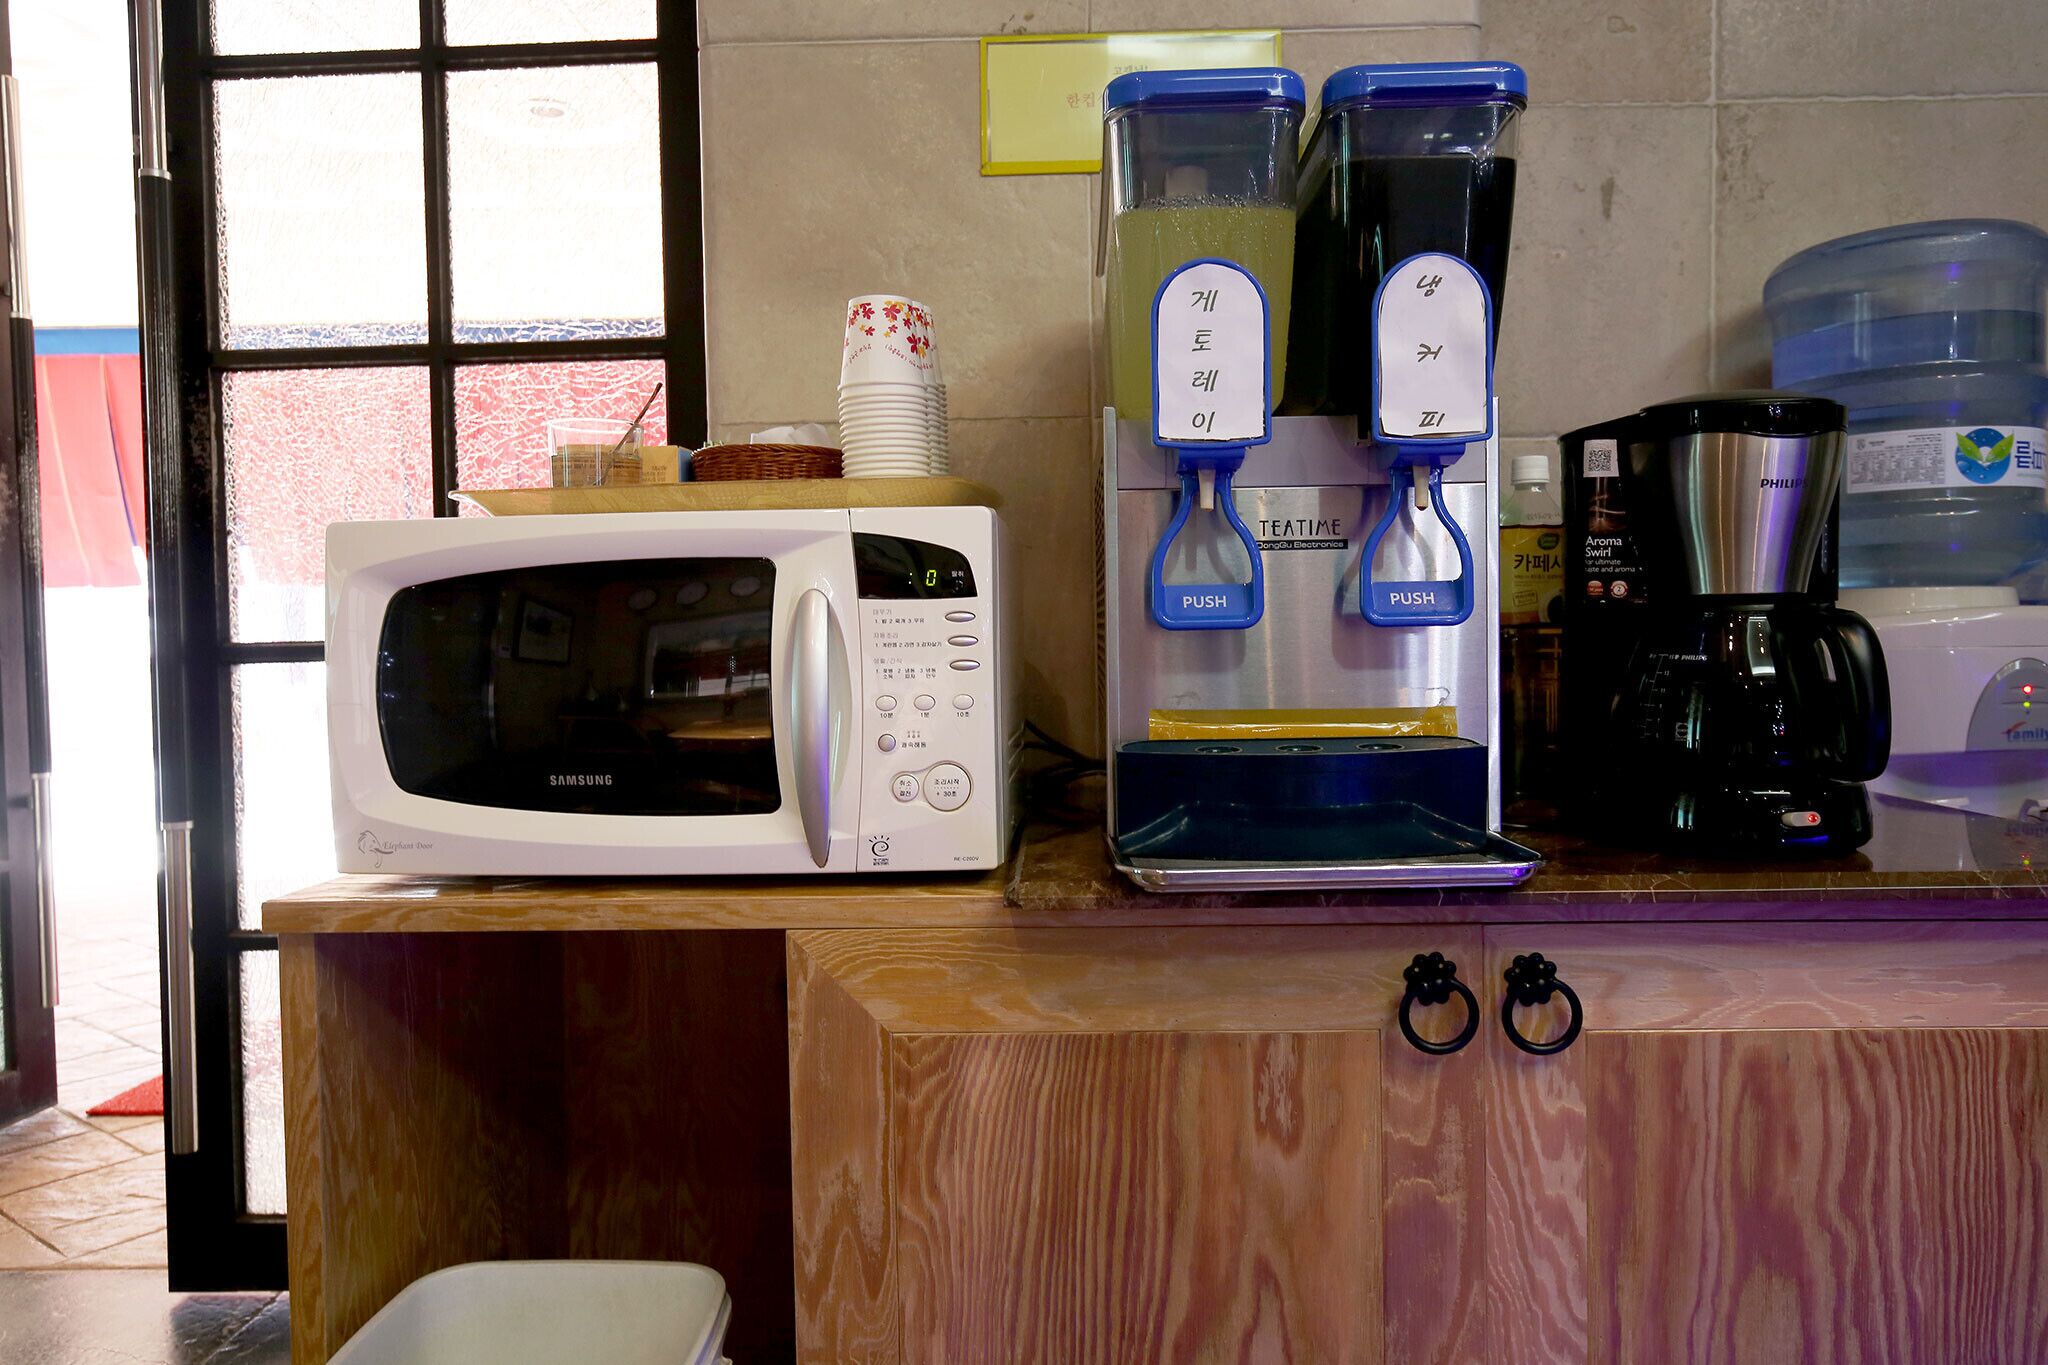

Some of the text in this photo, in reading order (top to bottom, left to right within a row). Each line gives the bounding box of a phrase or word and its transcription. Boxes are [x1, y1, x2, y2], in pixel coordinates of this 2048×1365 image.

[1066, 92, 1102, 108] 한컵
[1760, 477, 1809, 489] PHILIPS
[1259, 518, 1341, 536] TEATIME
[1293, 540, 1345, 549] Electronics
[1585, 535, 1623, 546] Aroma
[1585, 546, 1611, 557] Swirl
[1183, 596, 1227, 609] PUSH
[1389, 592, 1435, 605] PUSH
[550, 774, 613, 786] SAMSUNG
